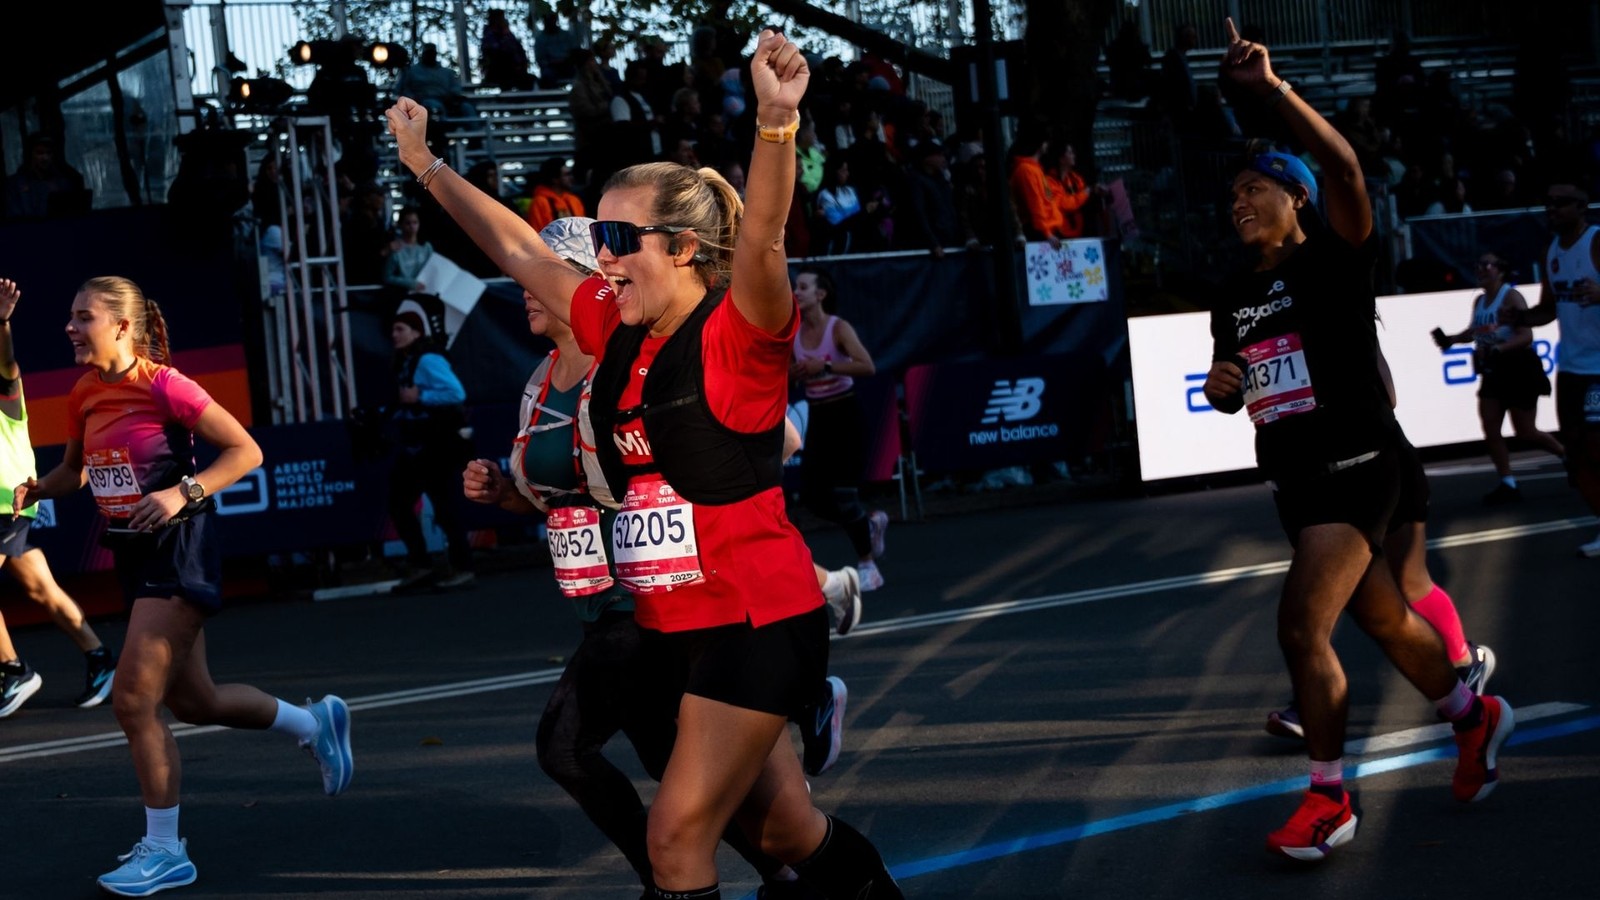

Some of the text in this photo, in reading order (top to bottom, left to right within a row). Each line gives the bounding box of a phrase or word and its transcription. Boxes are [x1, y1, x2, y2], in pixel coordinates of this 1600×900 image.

[968, 423, 1059, 446] new balance
[273, 459, 327, 475] ABBOTT
[274, 471, 324, 486] WORLD
[275, 480, 356, 498] MARATHON
[276, 493, 335, 511] MAJORS
[656, 496, 676, 504] TATA
[572, 517, 588, 525] TATA
[615, 508, 686, 550] 52205
[548, 528, 598, 558] 52952
[670, 573, 694, 583] 2025
